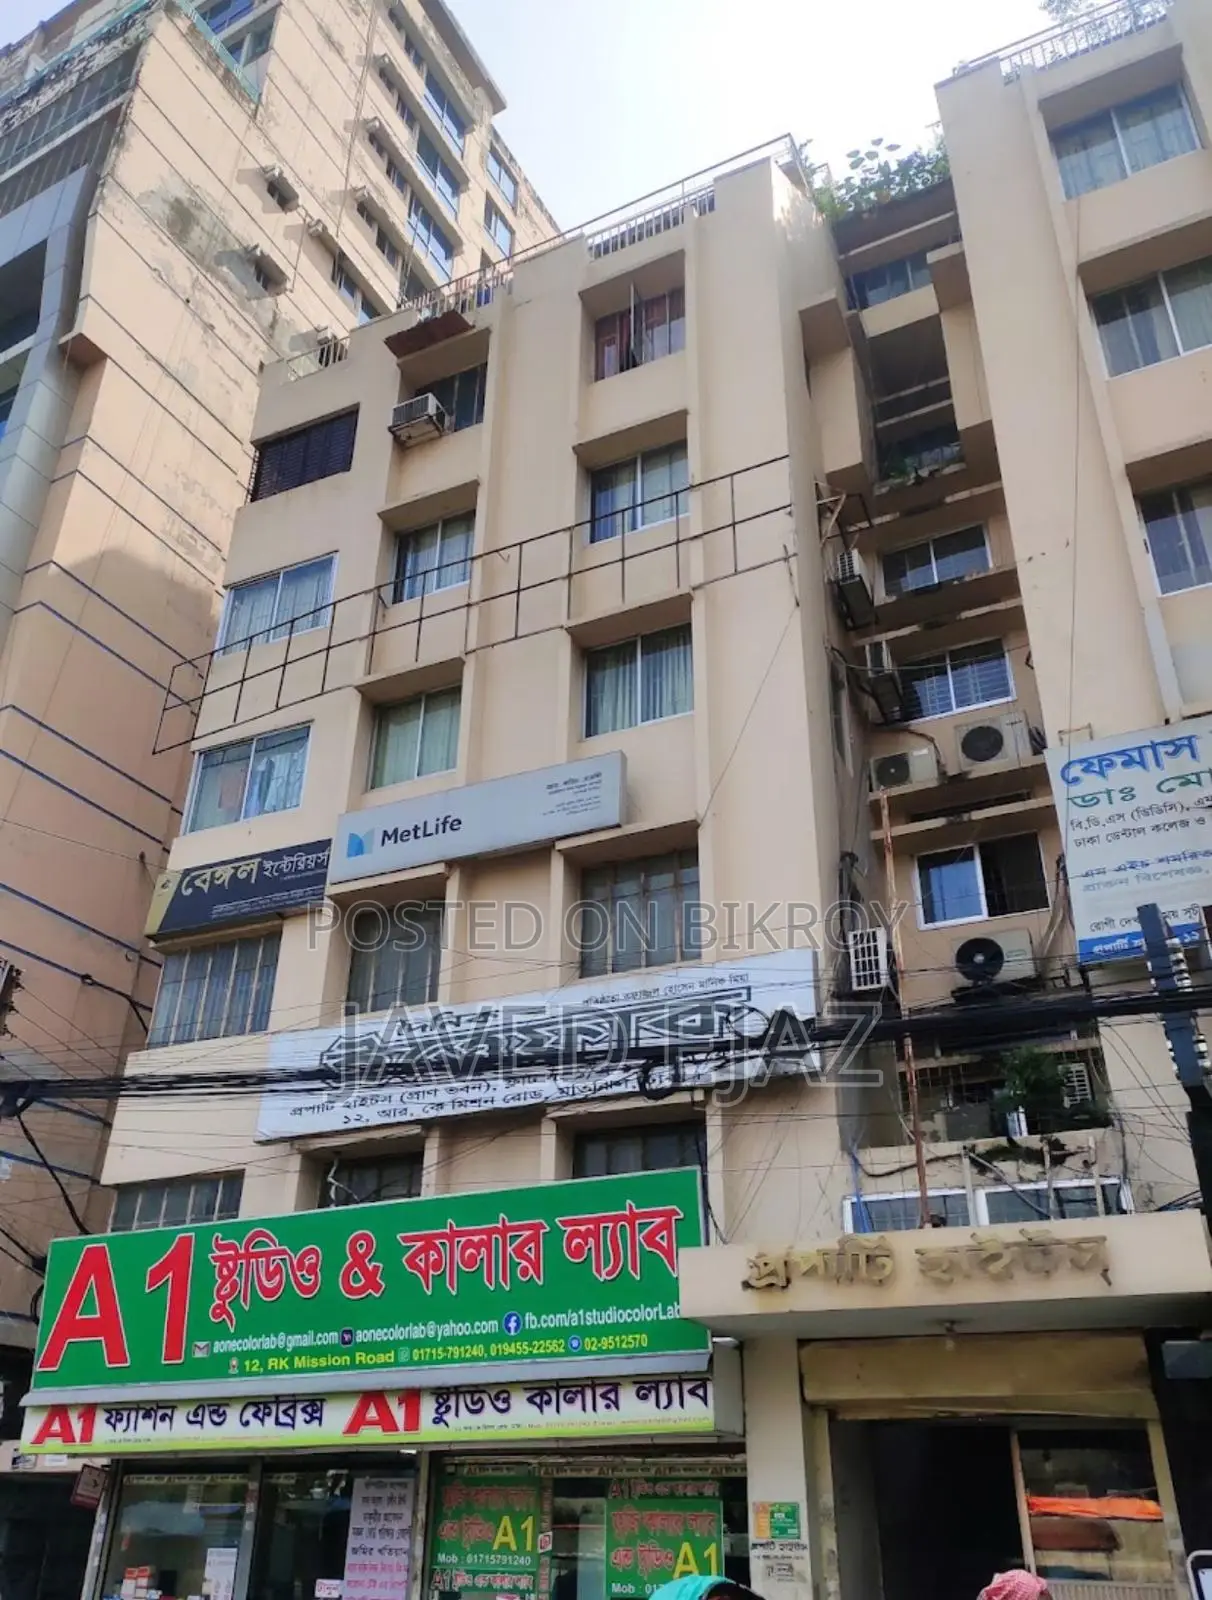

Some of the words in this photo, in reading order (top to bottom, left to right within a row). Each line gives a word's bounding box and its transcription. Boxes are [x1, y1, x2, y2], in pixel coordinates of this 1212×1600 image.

[1061, 735, 1199, 786] ফেমাস
[381, 815, 463, 847] MetLife
[181, 857, 262, 896] বেঙ্গল
[451, 1096, 495, 1111] মিশন
[340, 1231, 385, 1299] &
[397, 1212, 549, 1295] কালার
[555, 1199, 684, 1282] ল্যাব
[213, 1329, 339, 1354] aonecolorlab@gmail.com
[355, 1318, 499, 1343] aonecolorlab@yahoo.com
[243, 1358, 265, 1374] 12,
[267, 1356, 289, 1371] RK
[294, 1353, 350, 1369] Mission
[355, 1350, 395, 1365] Road
[584, 1333, 648, 1351] 02-9512570
[30, 1404, 98, 1447] A1
[103, 1402, 177, 1433] ফ্যাশন
[186, 1401, 230, 1428] এন্ড
[342, 1387, 423, 1437] A1
[524, 1379, 622, 1415] কালার
[632, 1375, 712, 1409] ল্যাব
[493, 1515, 534, 1551] A1
[437, 1552, 459, 1565] Mob
[672, 1540, 718, 1580] A1
[611, 1582, 635, 1595] Mob
